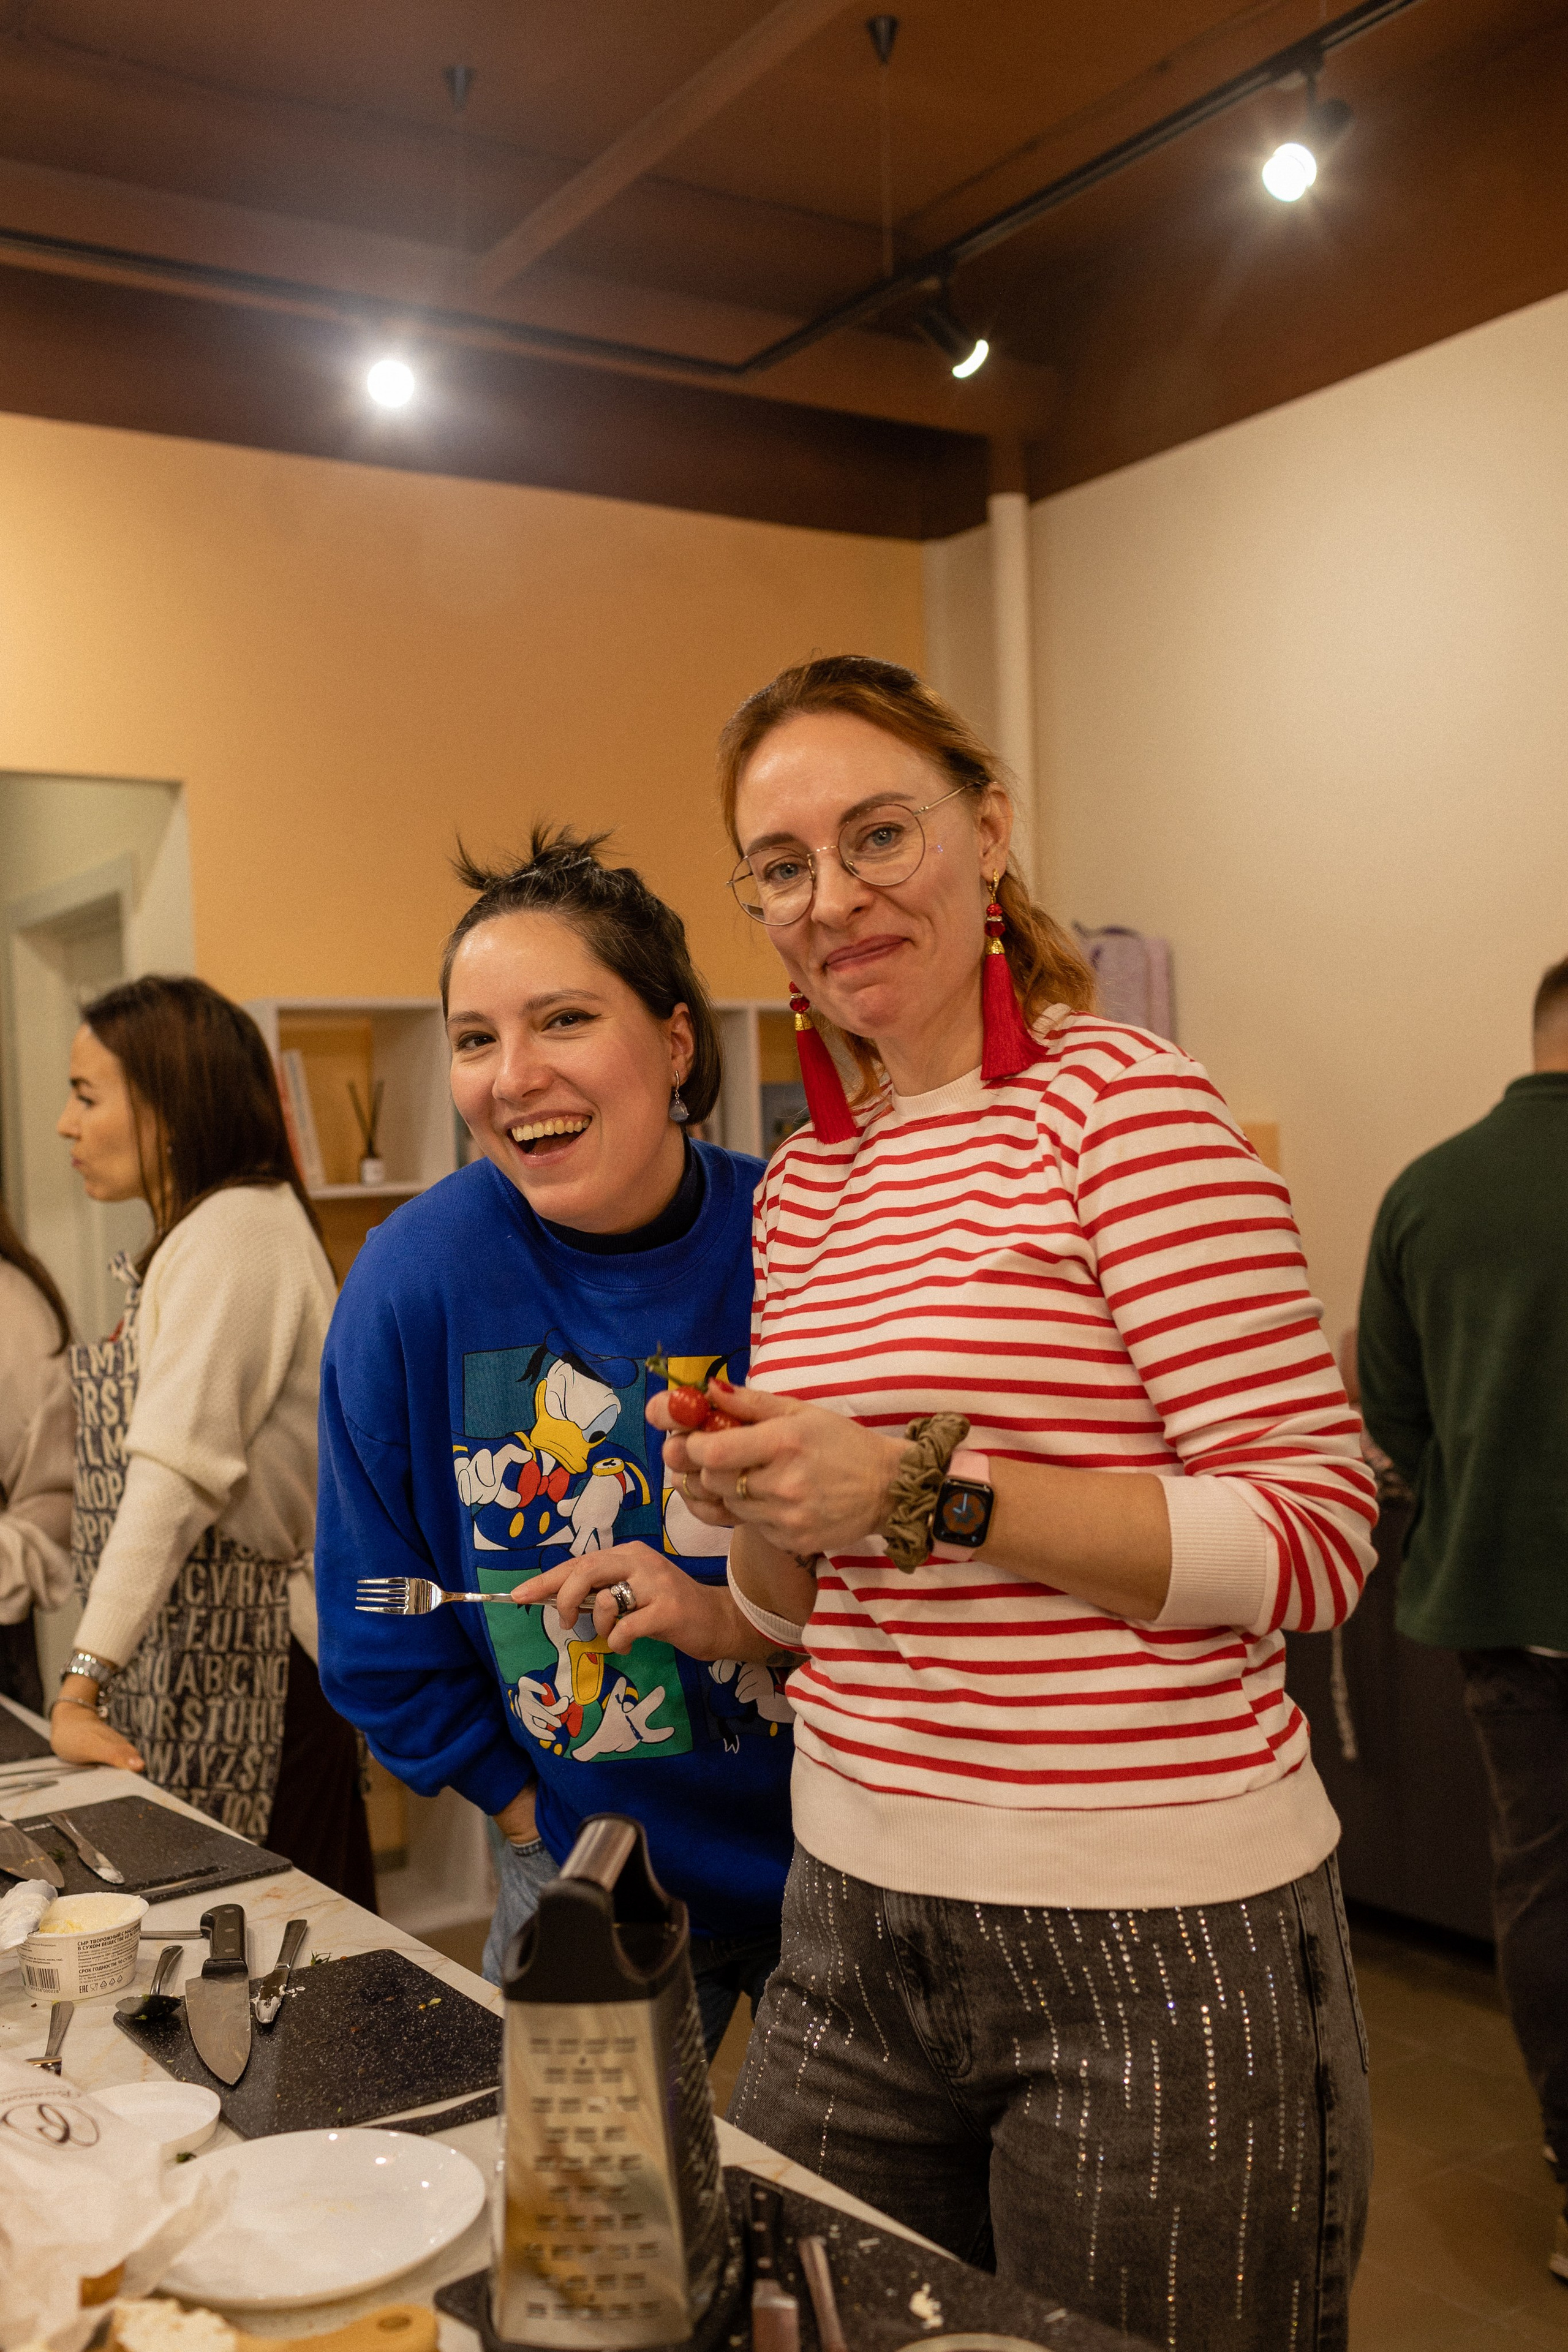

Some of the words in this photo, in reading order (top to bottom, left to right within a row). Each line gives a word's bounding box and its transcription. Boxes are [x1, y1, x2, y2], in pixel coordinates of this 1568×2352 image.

[90, 1933, 121, 1945] ТВОРОЖНЫЙ
[101, 1937, 124, 1947] ВЕЩЕСТВЕ
[92, 1962, 116, 1972] ГОДНОСТИ:
